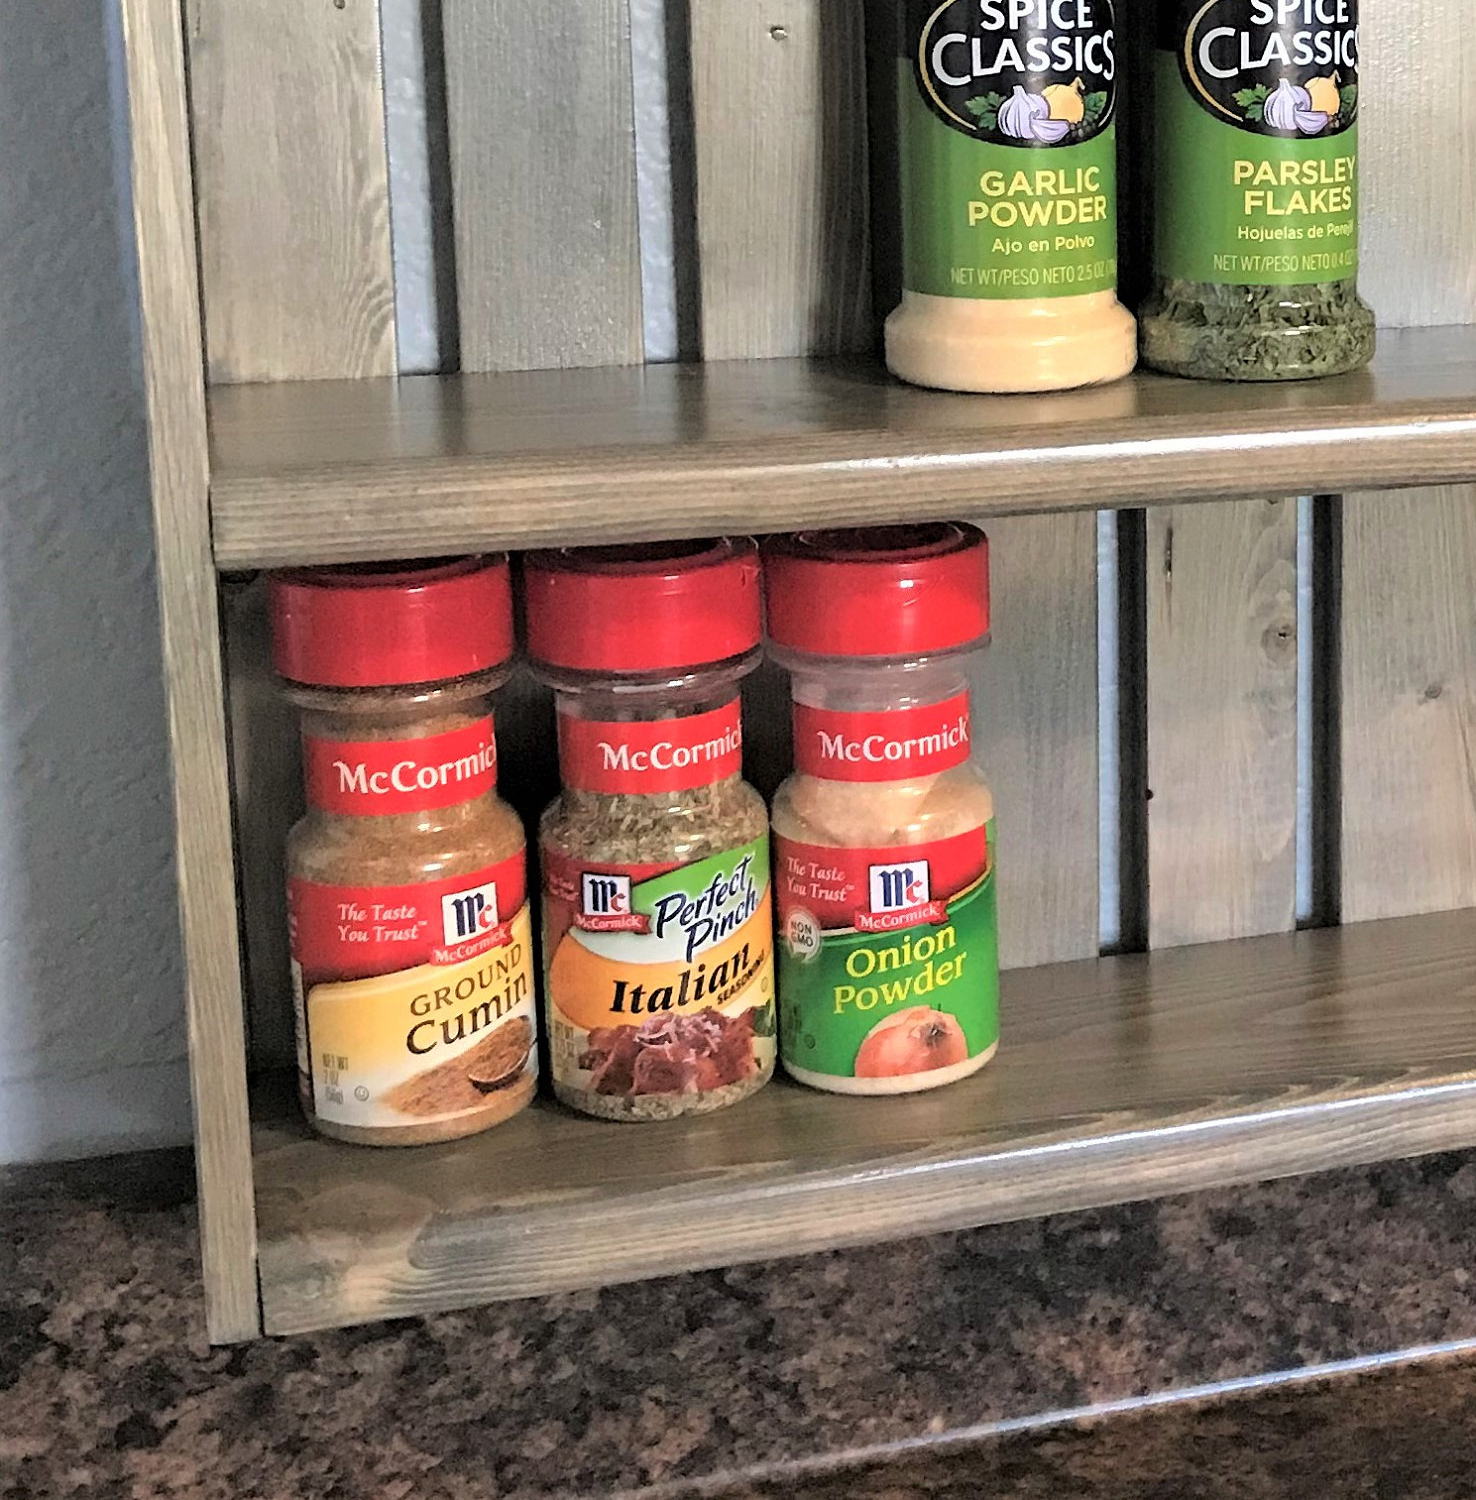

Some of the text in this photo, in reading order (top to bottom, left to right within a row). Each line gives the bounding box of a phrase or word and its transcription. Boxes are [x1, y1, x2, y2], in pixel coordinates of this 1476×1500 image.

[932, 29, 1115, 86] CLASSICS
[980, 166, 1100, 197] GARLIC
[1234, 155, 1356, 186] PARSLEY
[968, 195, 1107, 227] POWDER
[1244, 185, 1352, 215] FLAKES
[991, 234, 1095, 255] Ajo en Polvo
[1238, 225, 1303, 243] Hojuelas
[1307, 225, 1323, 239] de
[951, 267, 974, 285] NET
[977, 267, 1039, 287] WT/PESO
[1043, 265, 1075, 284] NETO
[1213, 254, 1237, 272] NET
[1240, 255, 1299, 273] WT/PESO
[1302, 253, 1330, 271] NETO
[817, 715, 968, 762] McCormick
[787, 856, 846, 881] The Taste
[655, 851, 755, 938] Perfect
[787, 876, 806, 895] You
[337, 903, 417, 922] The Taste
[576, 913, 642, 930] McCormick
[684, 877, 757, 963] Pinch
[858, 904, 941, 929] McCormick
[337, 925, 370, 942] You
[791, 921, 812, 935] NON
[791, 934, 814, 947] GMO
[434, 928, 507, 964] McCormick
[846, 925, 956, 978] Onion
[410, 943, 522, 1016] GROUND
[609, 942, 750, 1014] Italian
[833, 951, 967, 1014] Powder
[406, 971, 527, 1055] Cumin
